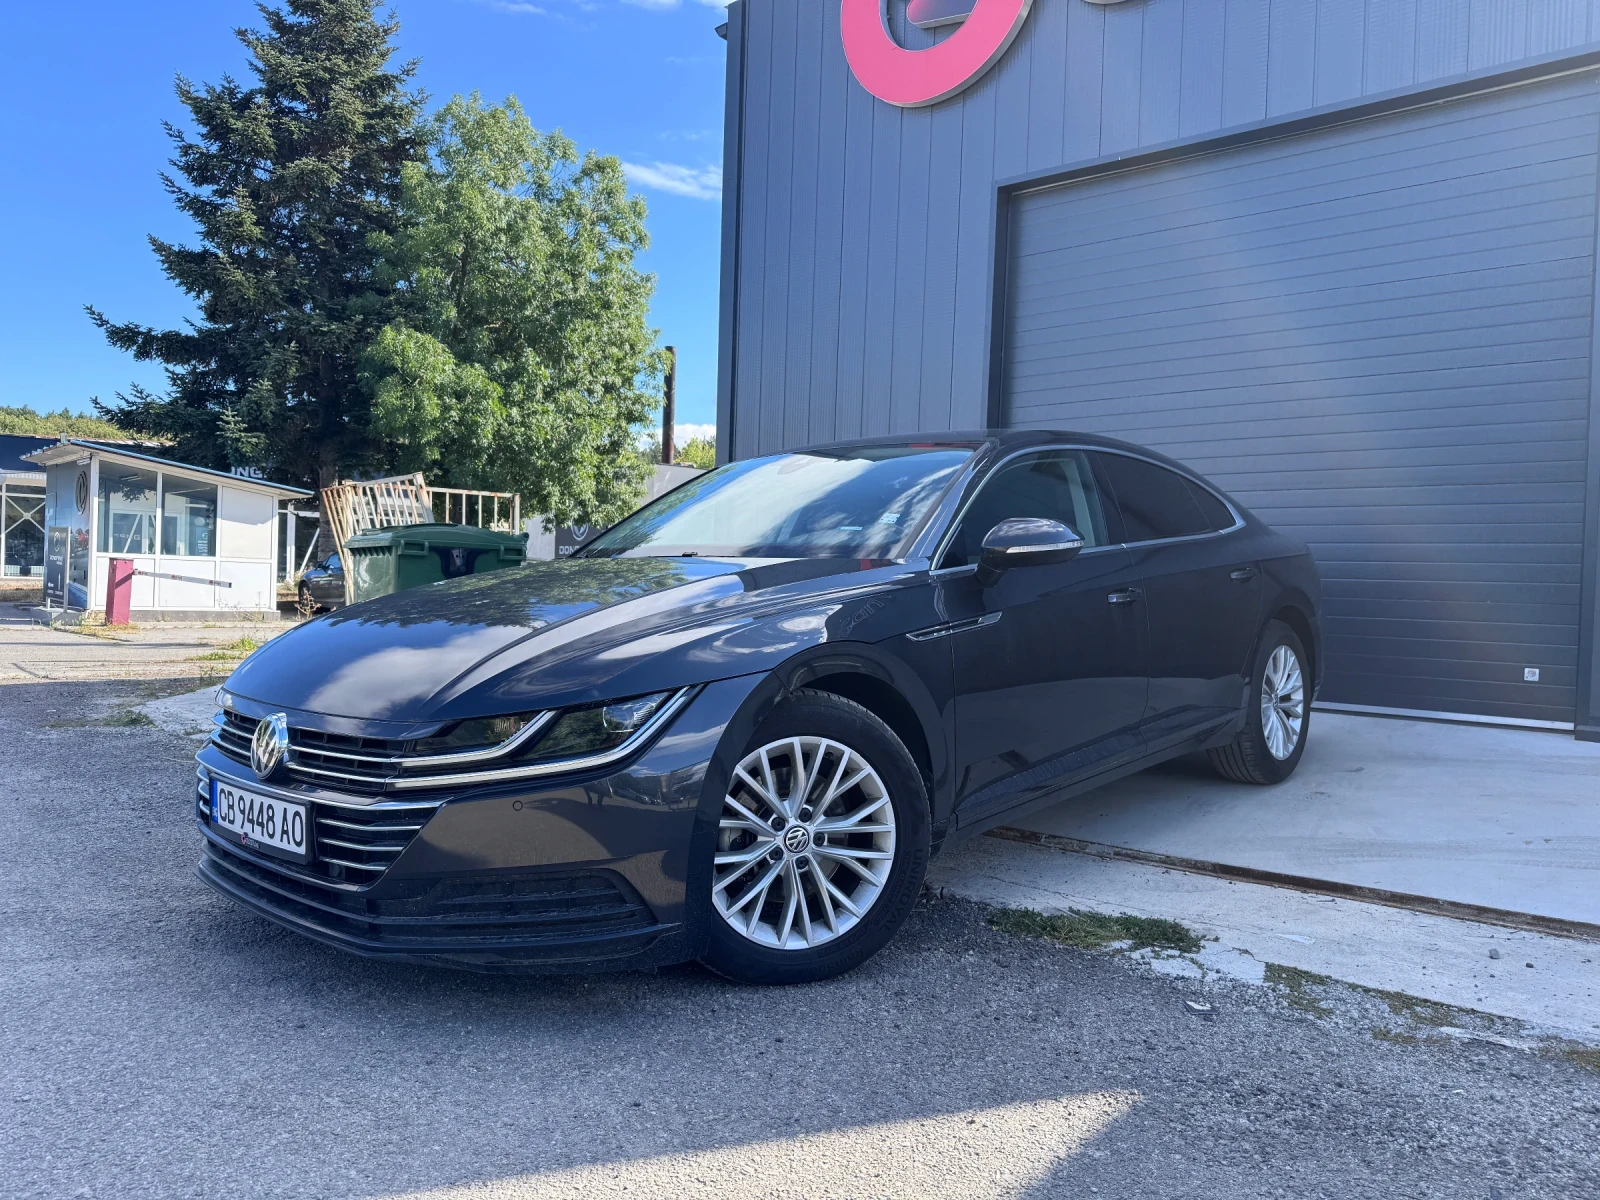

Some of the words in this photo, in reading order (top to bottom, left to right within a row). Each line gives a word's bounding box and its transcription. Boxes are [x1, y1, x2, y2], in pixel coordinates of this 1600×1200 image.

[218, 788, 236, 825] CB
[238, 795, 276, 839] 9448
[280, 807, 304, 847] AO
[878, 848, 924, 932] UNIROYAL
